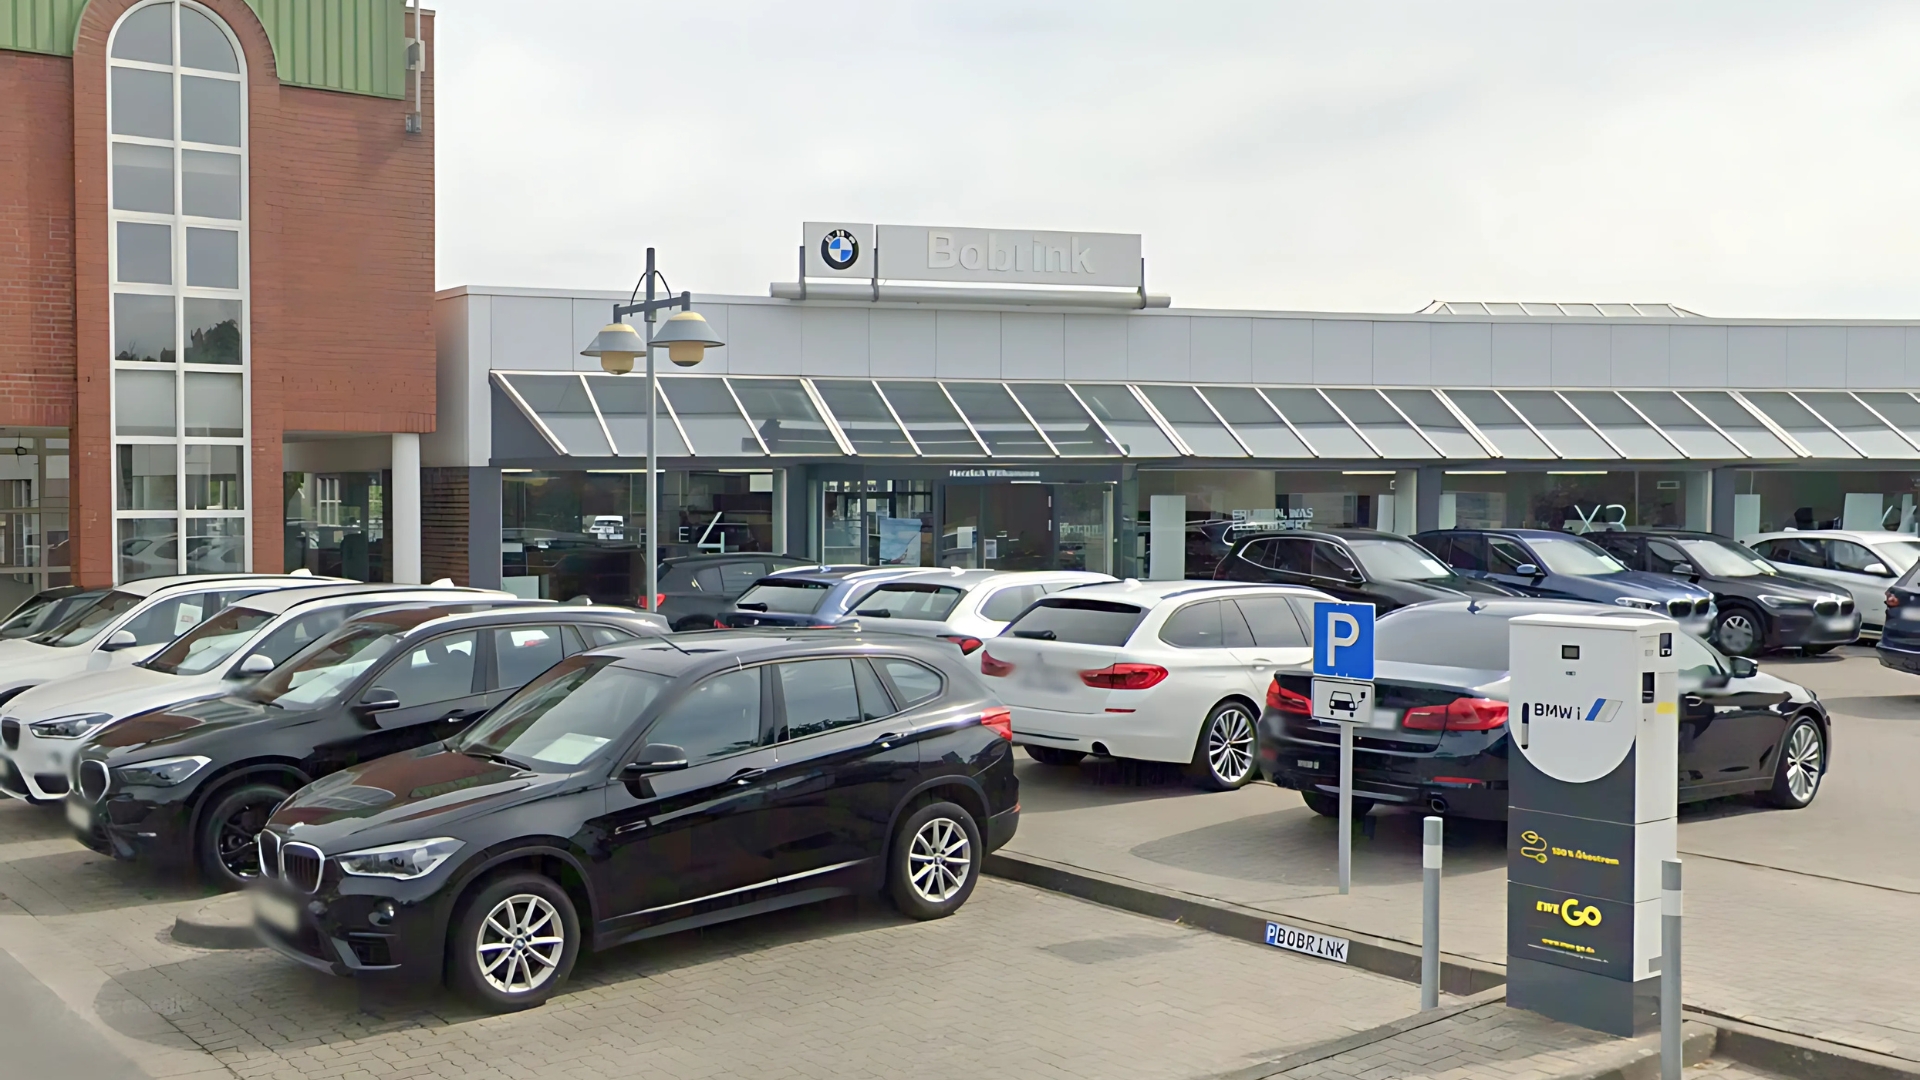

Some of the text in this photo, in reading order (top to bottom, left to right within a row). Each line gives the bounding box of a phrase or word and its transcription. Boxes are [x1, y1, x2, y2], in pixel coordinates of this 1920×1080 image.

[928, 231, 1096, 274] Bobrink
[1327, 612, 1360, 667] P
[1534, 702, 1573, 719] BMW
[1277, 927, 1345, 960] BOBRINK
